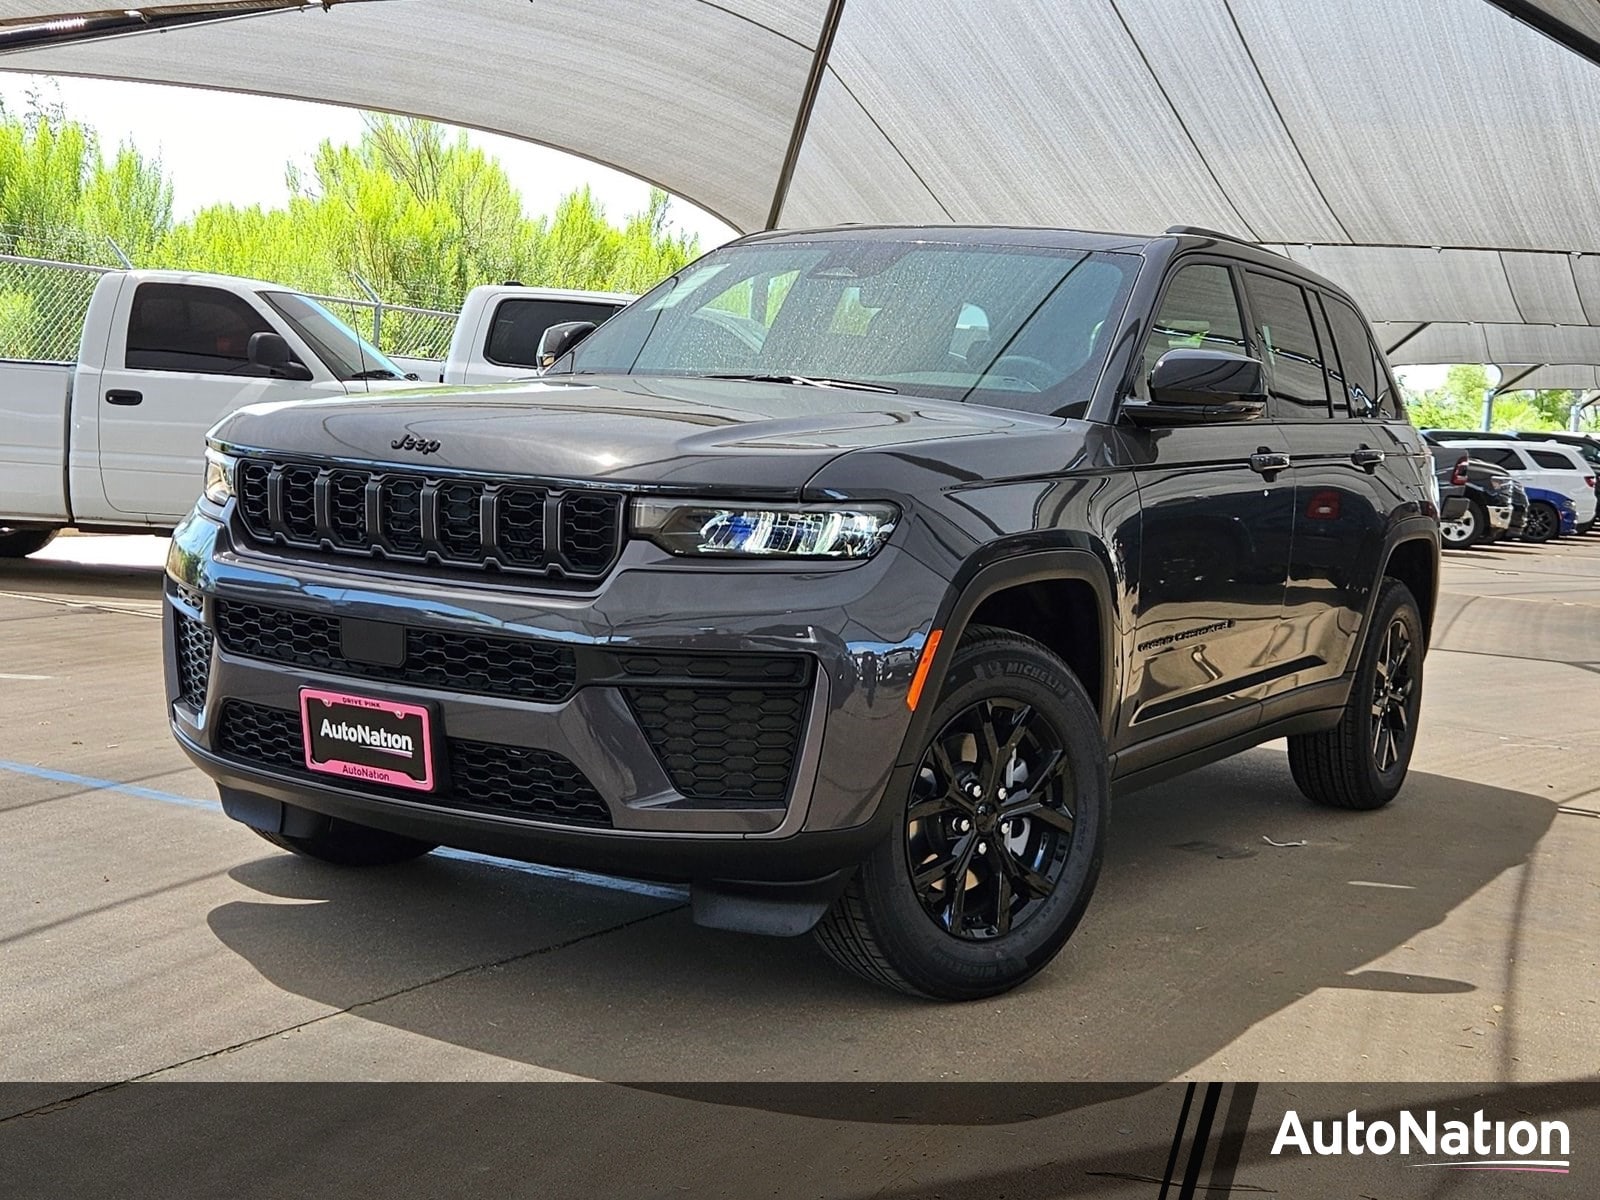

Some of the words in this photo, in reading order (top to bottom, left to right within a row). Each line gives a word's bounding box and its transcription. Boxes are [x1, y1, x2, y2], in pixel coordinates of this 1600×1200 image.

[391, 434, 441, 455] Jeep
[1006, 662, 1068, 698] MICHELIN
[342, 697, 362, 706] DRIVE
[320, 718, 413, 750] AutoNation
[342, 765, 390, 782] AutoNation
